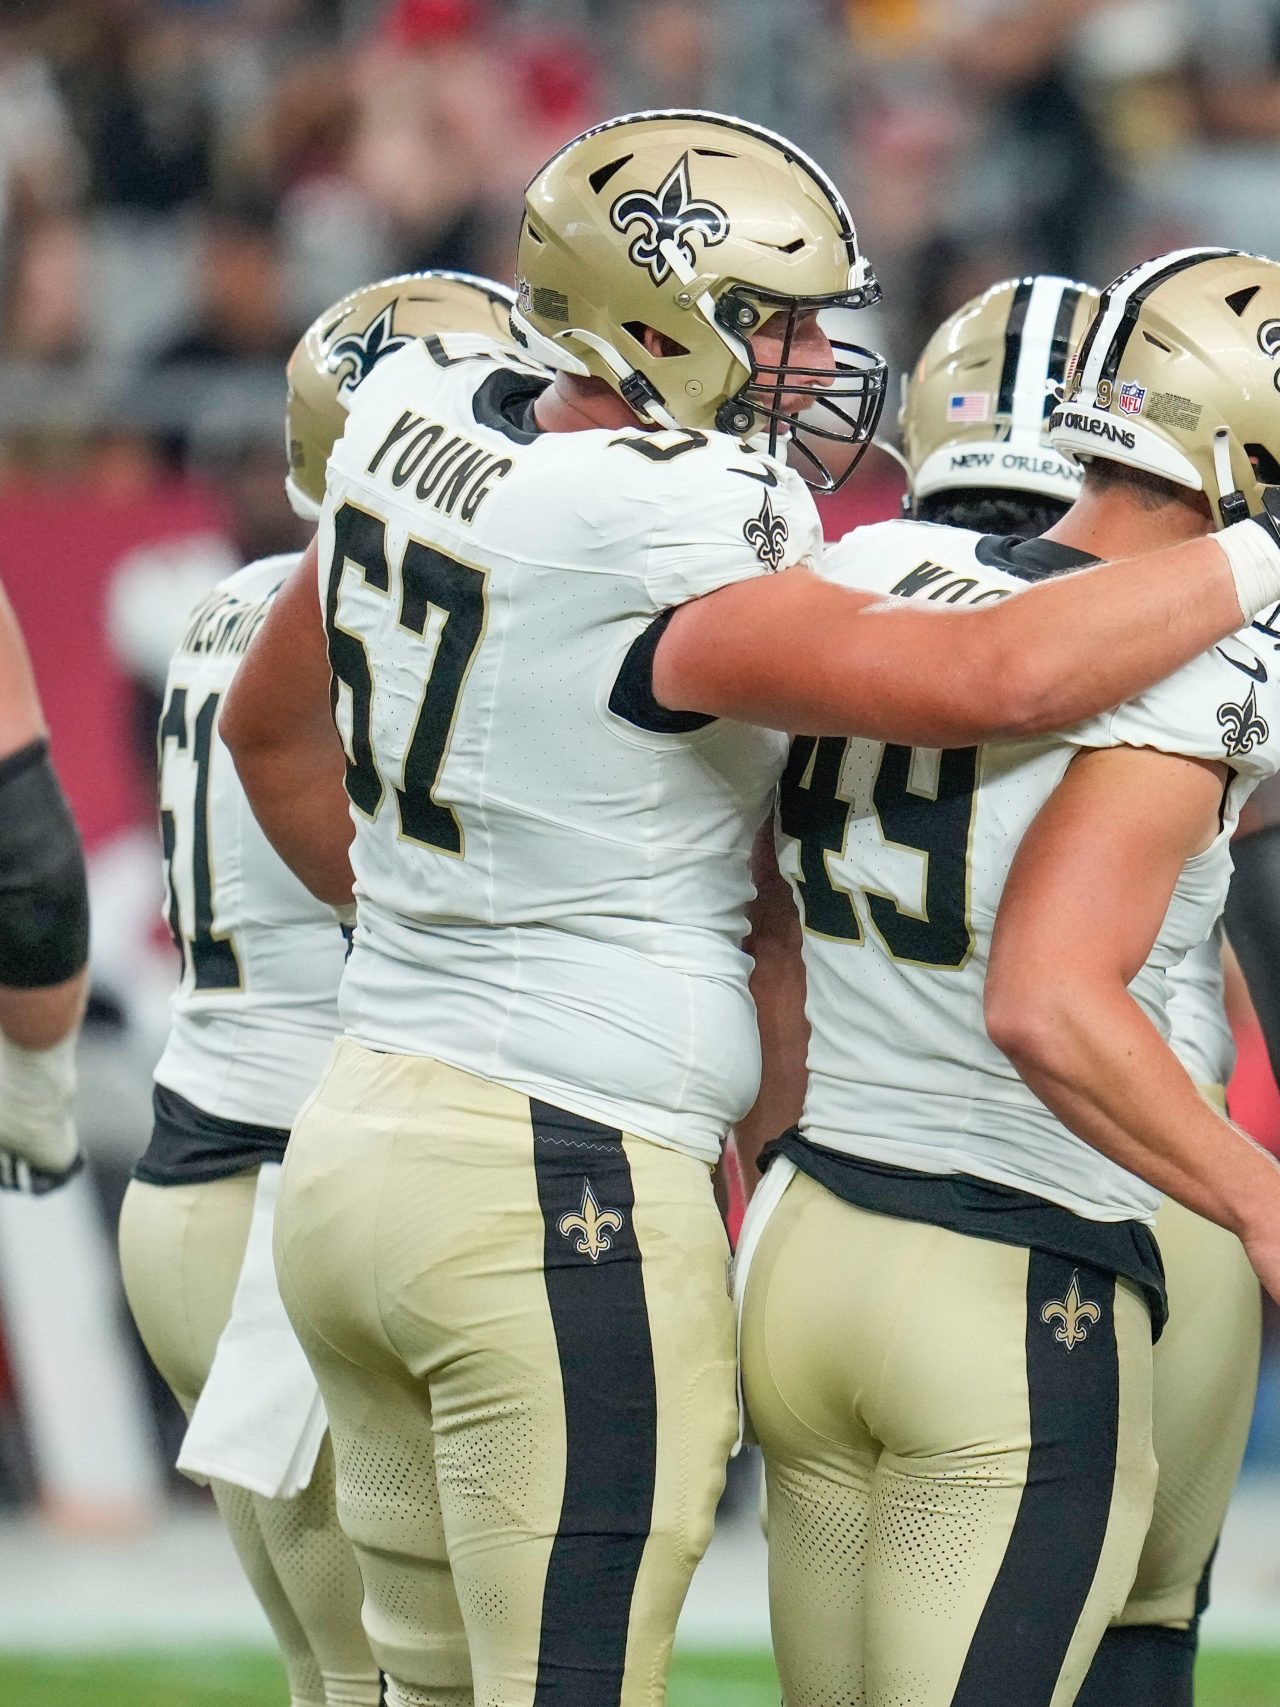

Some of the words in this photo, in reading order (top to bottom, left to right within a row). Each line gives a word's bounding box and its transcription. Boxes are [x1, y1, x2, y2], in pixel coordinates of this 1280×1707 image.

[1064, 412, 1136, 449] ORLEANS
[1121, 395, 1140, 412] NFL
[364, 406, 518, 527] YOUNG
[951, 453, 994, 472] NEW
[1002, 454, 1081, 484] ORLEAN
[325, 496, 491, 862] 67
[157, 685, 246, 994] 61
[777, 735, 985, 972] 49
